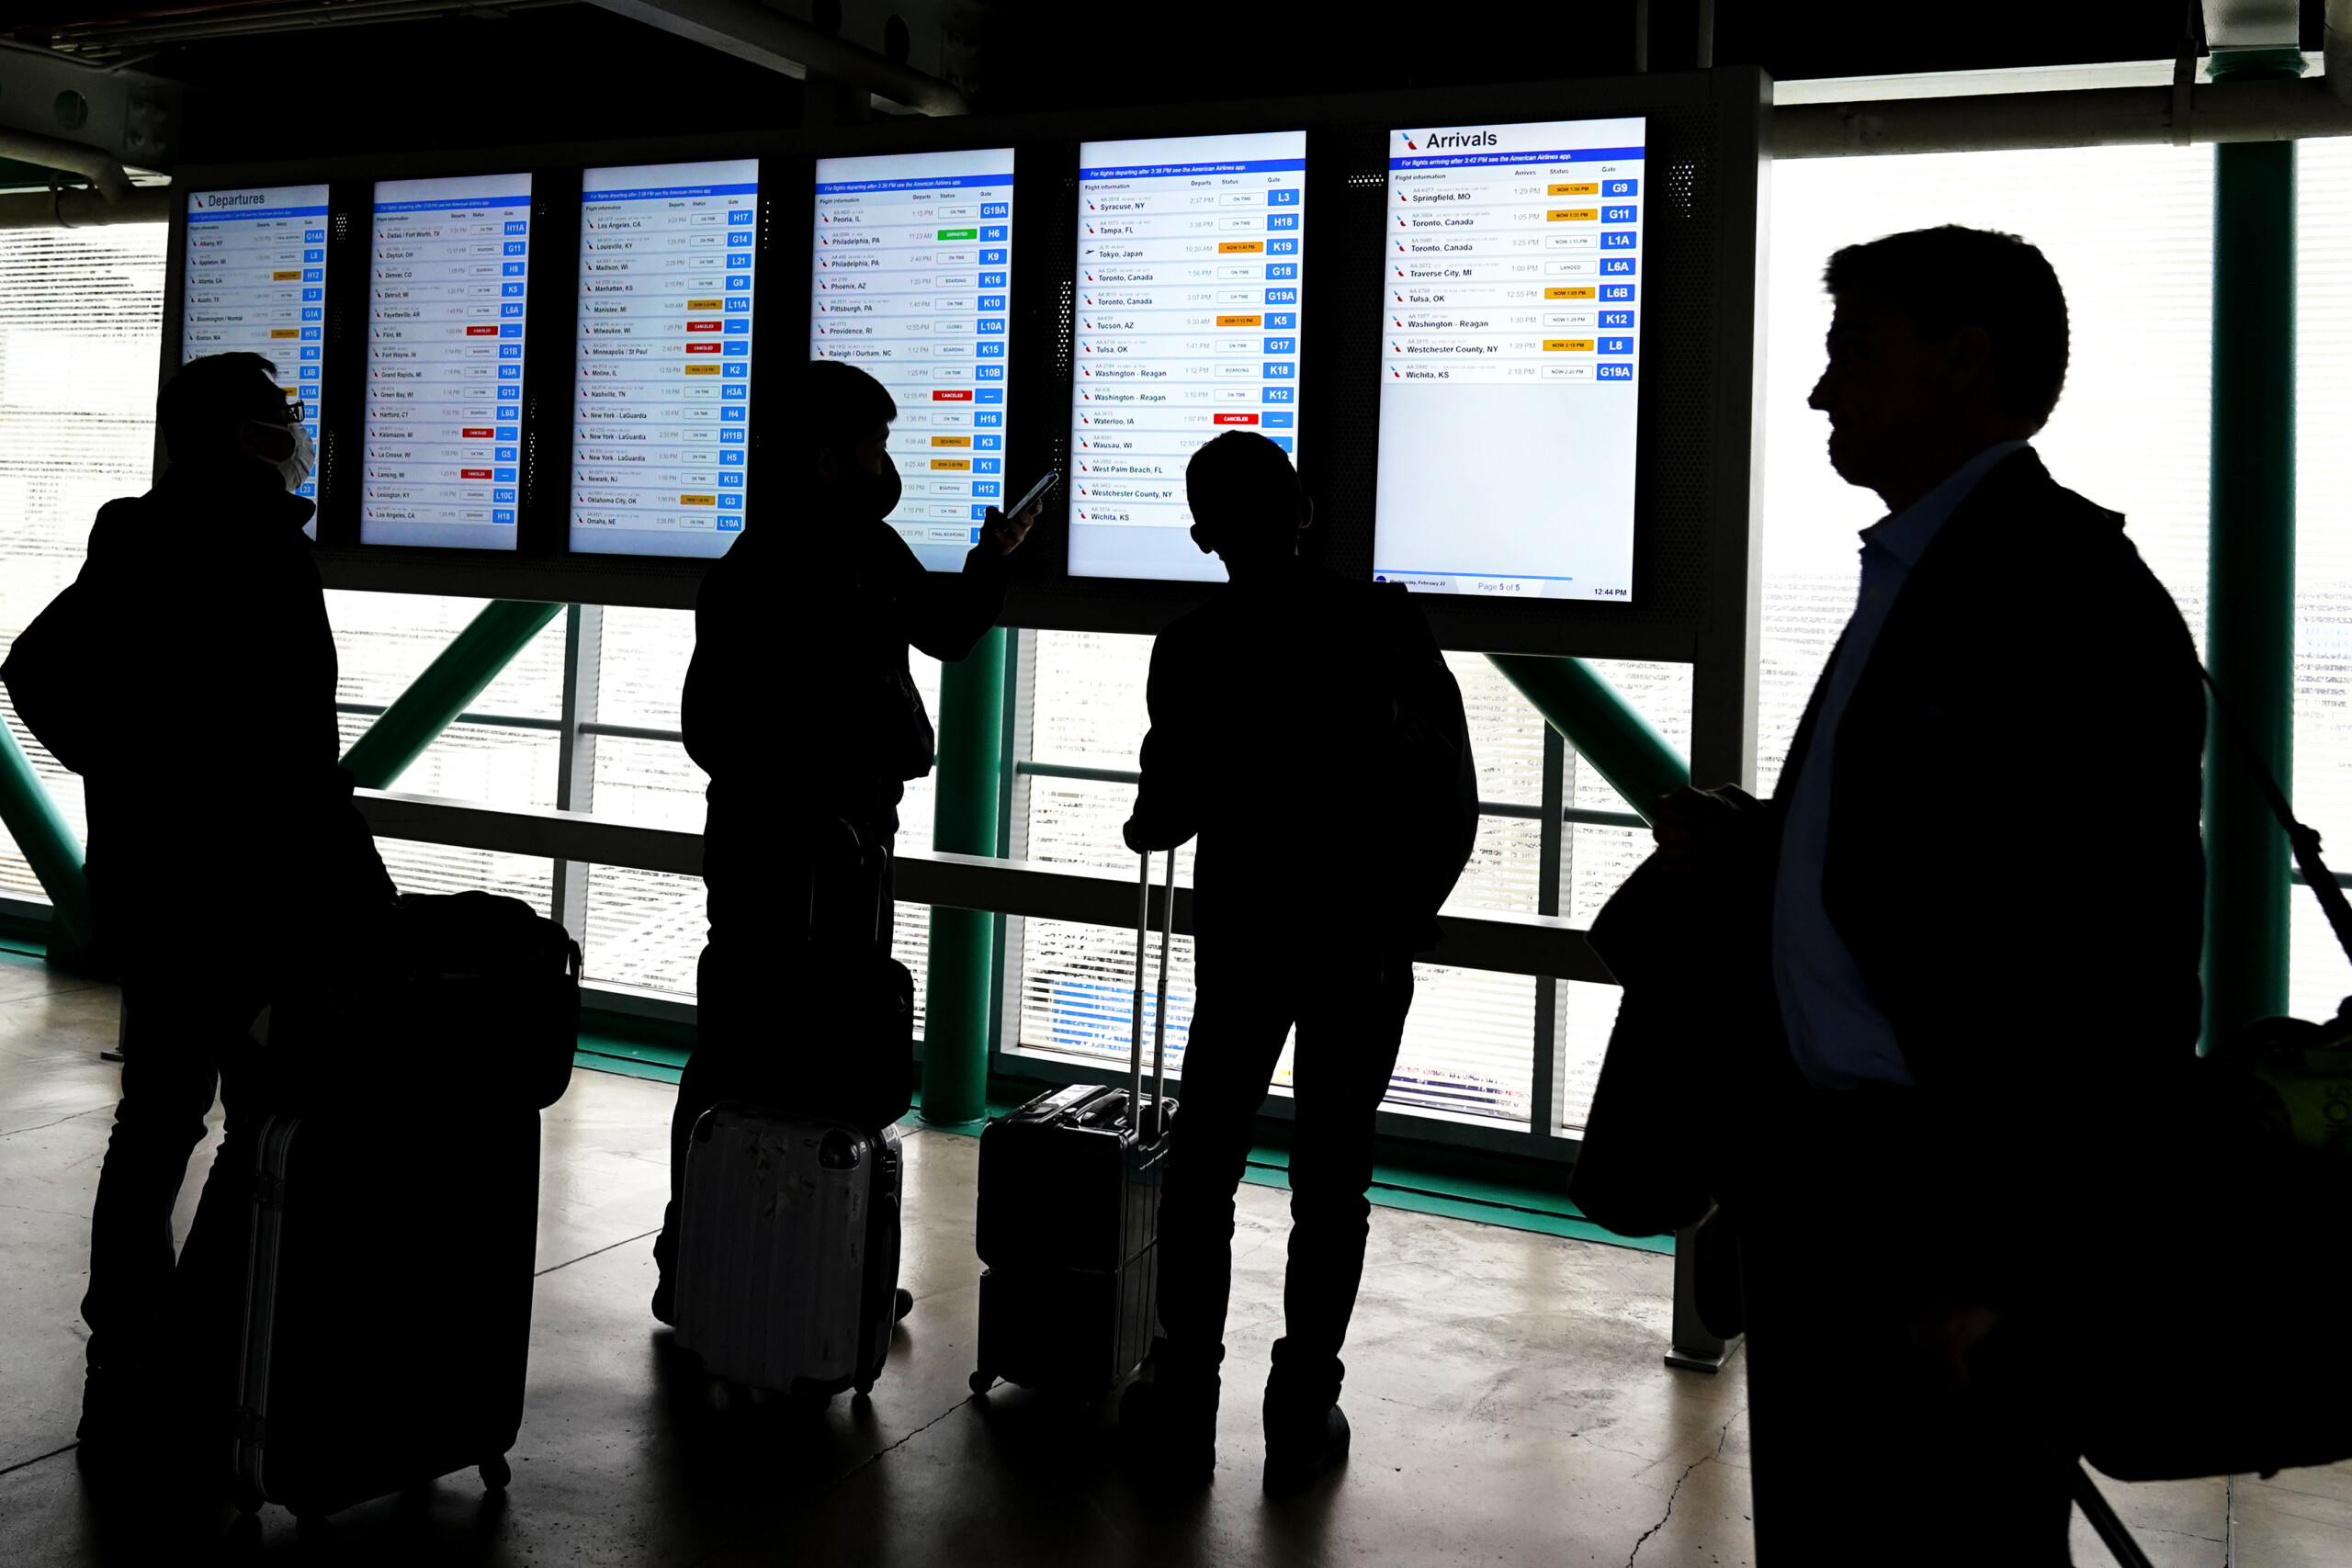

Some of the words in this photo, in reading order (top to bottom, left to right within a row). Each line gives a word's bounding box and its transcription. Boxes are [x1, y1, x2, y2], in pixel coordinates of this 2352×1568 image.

[1427, 131, 1498, 148] Arrivals
[1612, 183, 1628, 193] G9
[209, 194, 265, 208] Departures
[1278, 193, 1290, 202] L3
[1413, 194, 1456, 203] Springfield,
[1101, 203, 1133, 211] Syracuse,
[1609, 209, 1629, 220] G11
[1274, 218, 1293, 226] H18
[988, 230, 1000, 238] H6
[1100, 227, 1124, 235] Tampa,
[1608, 236, 1629, 245] L1A
[1273, 243, 1292, 251] K19
[1100, 251, 1120, 259] Tokyo,
[1123, 250, 1143, 258] Japan
[1272, 267, 1292, 276] G18
[1607, 262, 1629, 272] L6A
[1443, 269, 1461, 278] City,
[985, 276, 1001, 284] K16
[1268, 292, 1294, 300] G19A
[1607, 288, 1628, 298] L6B
[1274, 317, 1287, 325] K5
[1459, 320, 1488, 328] Reagan
[1606, 315, 1627, 324] K12
[1271, 342, 1289, 350] G17
[1456, 345, 1485, 354] County,
[1610, 341, 1623, 350] L8
[1270, 367, 1288, 375] K18
[1600, 367, 1630, 377] G19A
[1269, 391, 1287, 400] K12
[982, 438, 993, 446] K3
[1135, 491, 1161, 499] County,
[1478, 582, 1498, 592] Page
